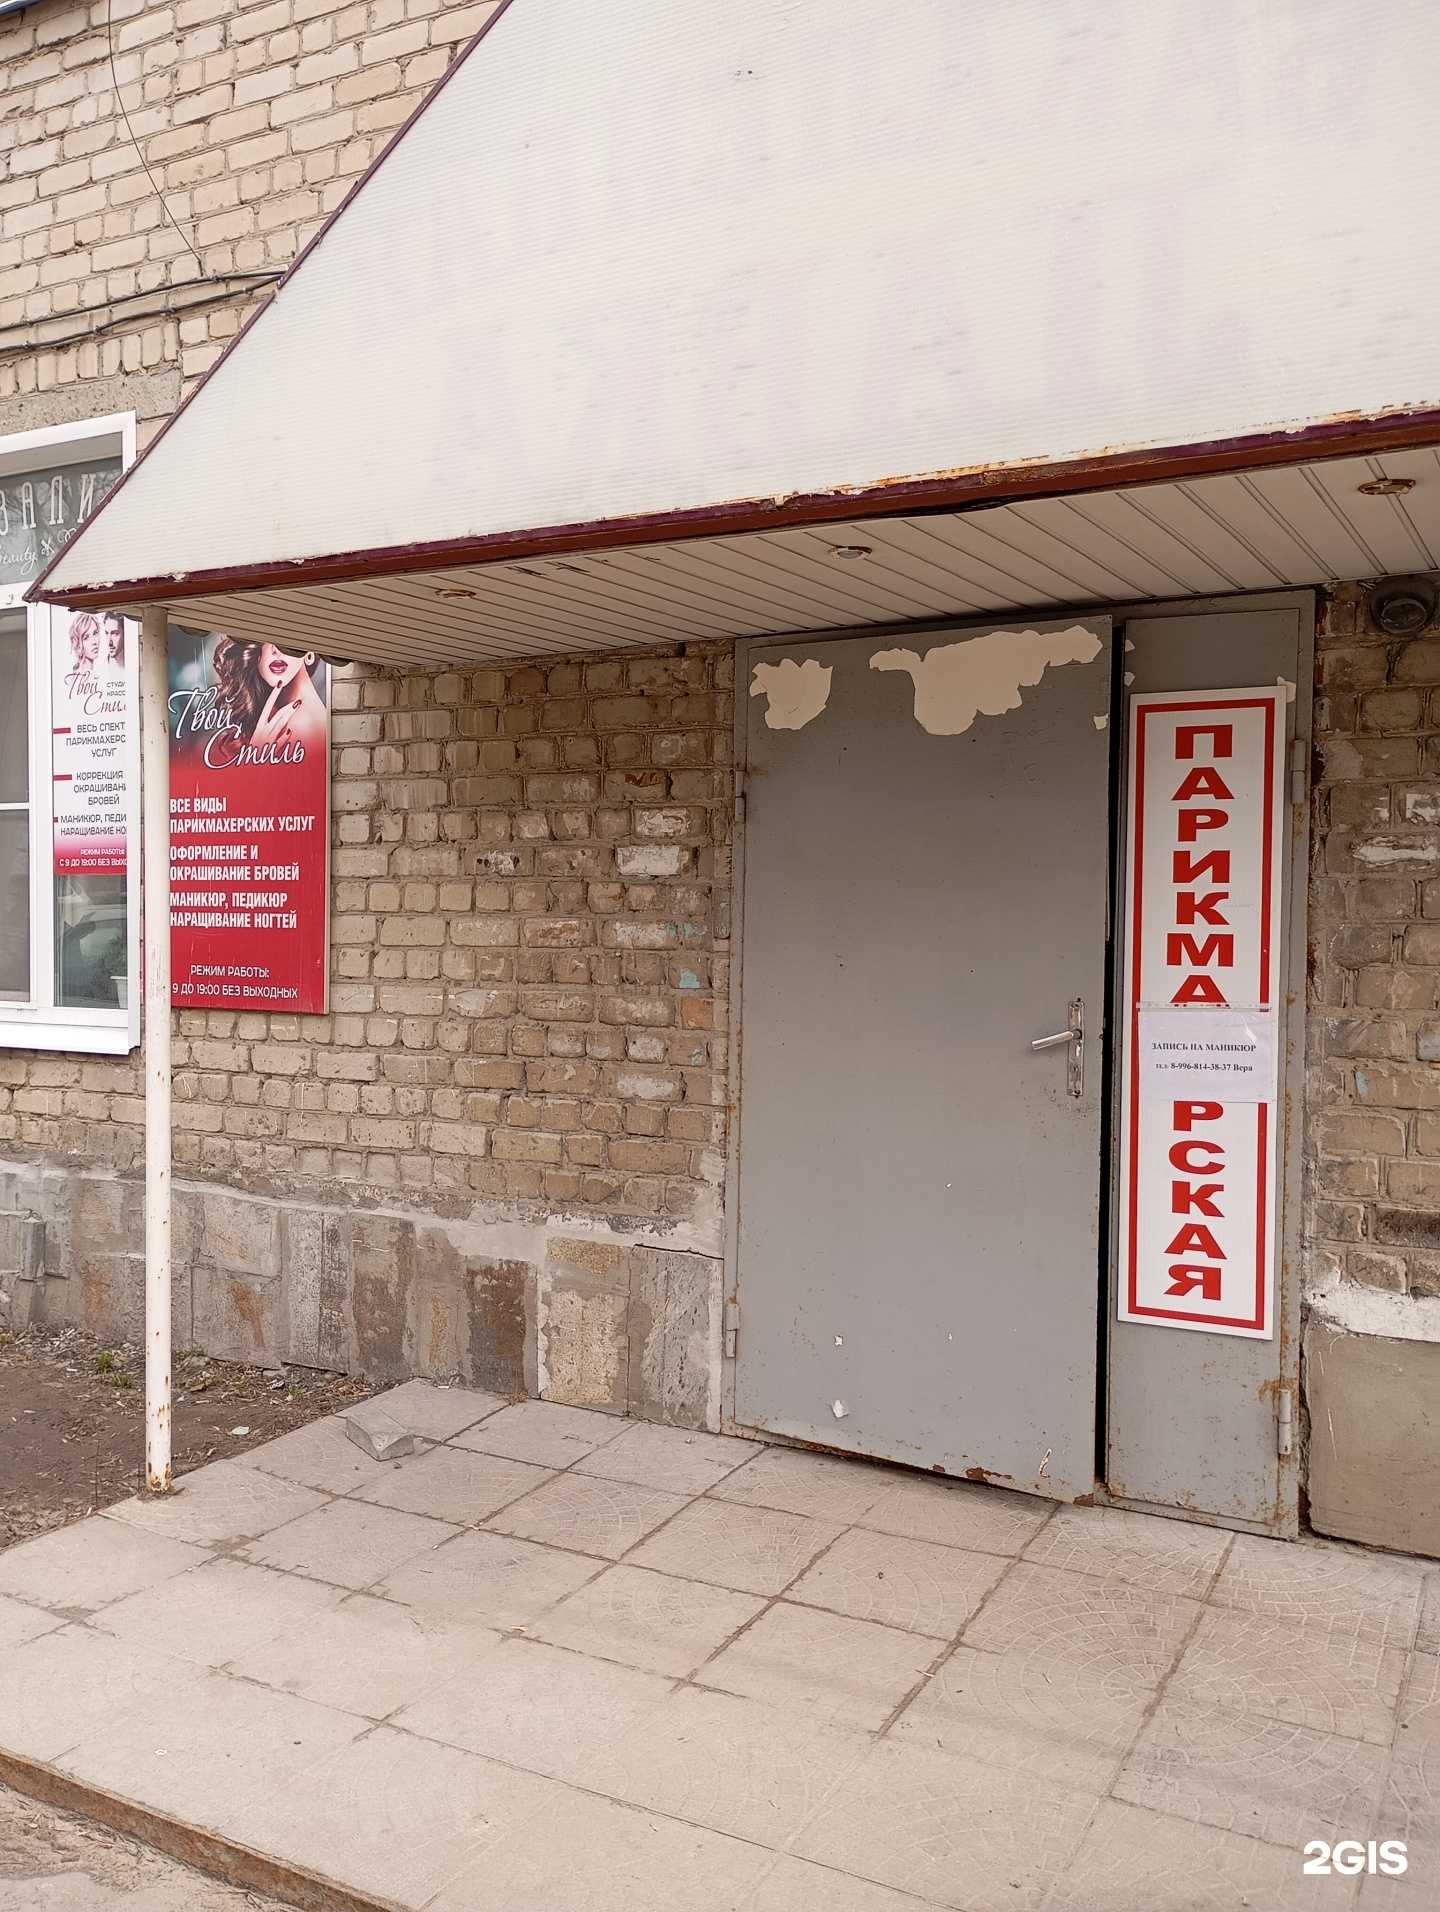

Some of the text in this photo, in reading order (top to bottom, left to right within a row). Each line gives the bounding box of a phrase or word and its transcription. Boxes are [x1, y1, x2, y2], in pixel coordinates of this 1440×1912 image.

[64, 671, 98, 700] Твой
[168, 686, 235, 739] Твой
[77, 722, 126, 734] ВЕСЬ СПЕКТ
[91, 748, 117, 757] УСЛУГ
[204, 724, 305, 769] Стиль
[76, 771, 123, 781] КОРРЕКЦИЯ
[88, 794, 120, 805] БРОВЕЙ
[170, 797, 226, 813] ВСЕ ВИДЫ
[60, 815, 102, 824] МАНИКЮР,
[170, 815, 315, 833] ПАРИКМАХЕРСКИХ УСЛУГ
[60, 826, 114, 836] НАРАЩИВАНИЕ
[170, 845, 258, 860] ОФОРМЛЕНИЕ И
[170, 862, 299, 881] ОКРАШИВАНИЕ БРОВЕЙ
[170, 892, 288, 910] МАНИКЮР, ПЕДИКЮР
[170, 910, 297, 929] НАРАЩИВАНИЕ НОГТЕЙ
[190, 965, 270, 978] РЕЖИМ РАБОТЫ:
[172, 983, 298, 999] 9 ДО 19:00 БЕЗ ВЫХОДНЫХ
[1164, 724, 1235, 1301] ПАРИКМАРСКАЯ
[1152, 1042, 1257, 1052] ЗАПИСЬ НА МАНИКЮР
[1233, 1064, 1253, 1073] Вера
